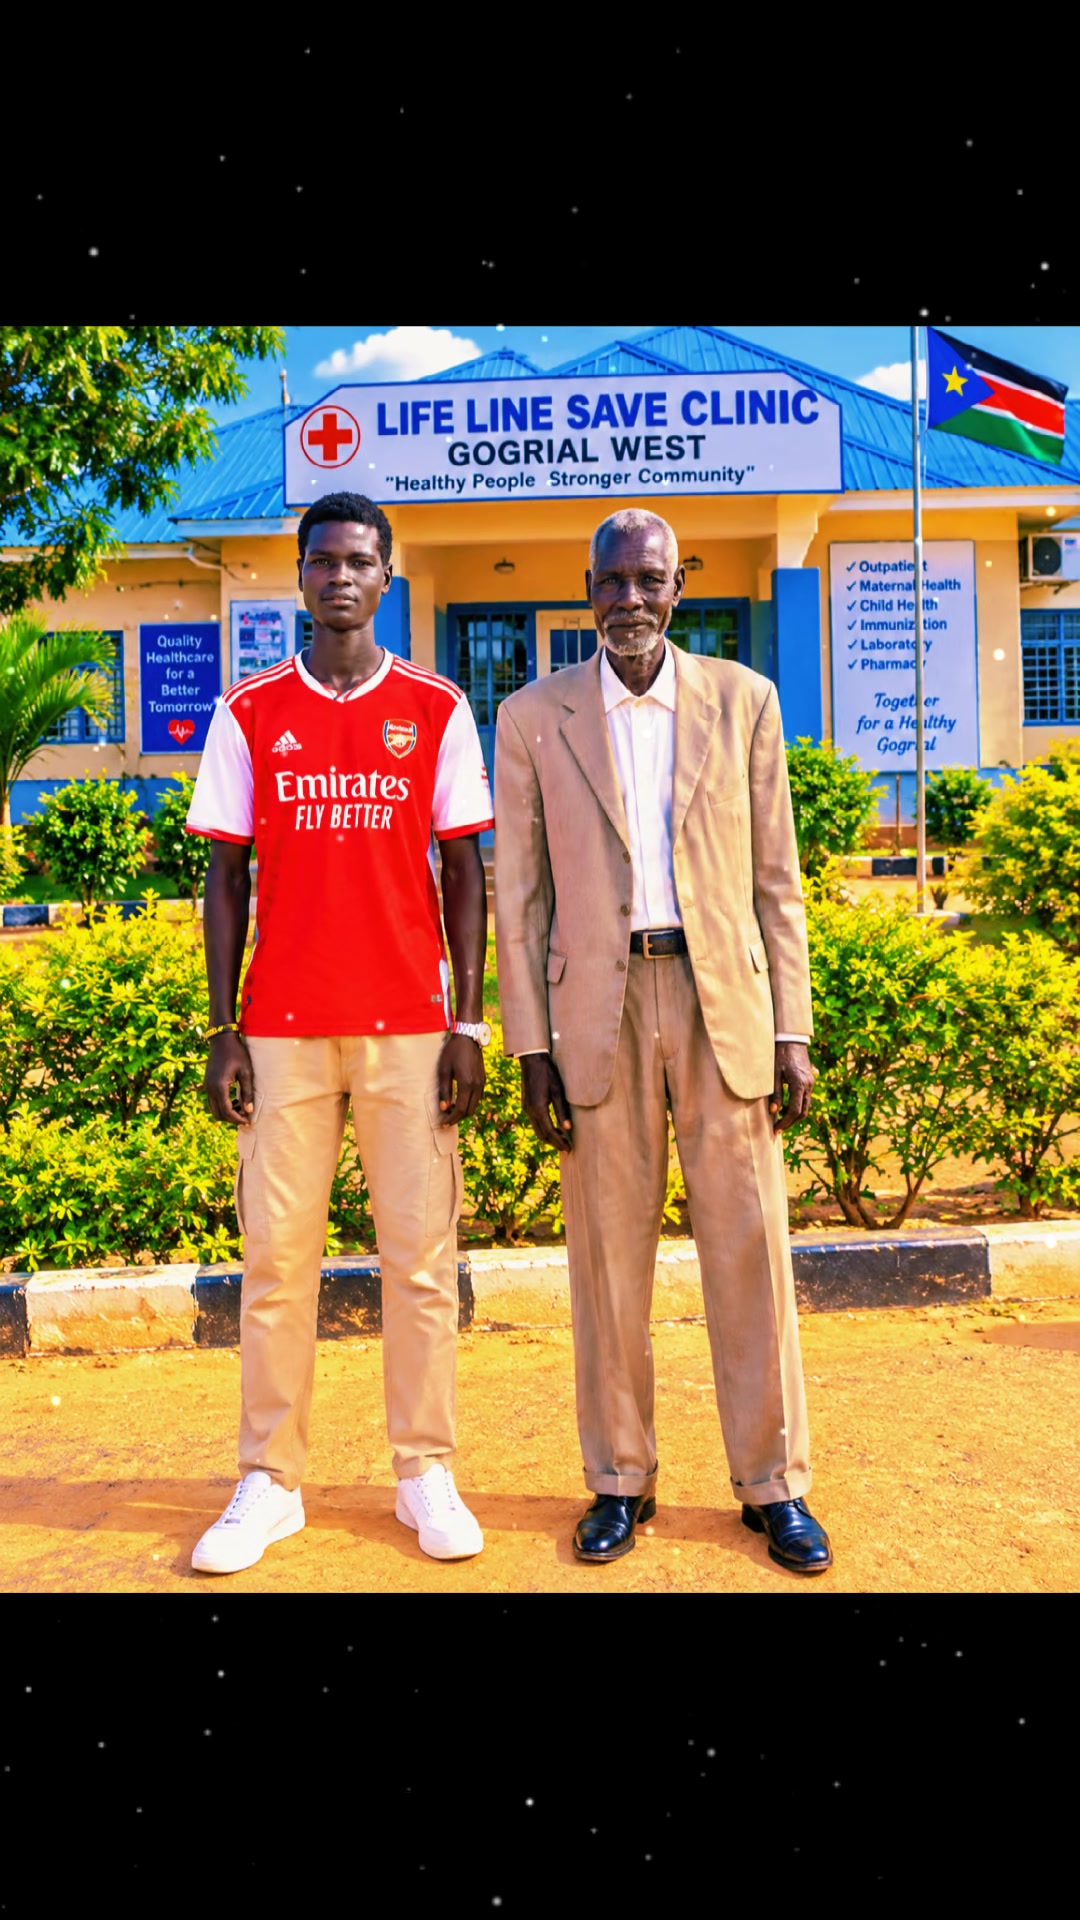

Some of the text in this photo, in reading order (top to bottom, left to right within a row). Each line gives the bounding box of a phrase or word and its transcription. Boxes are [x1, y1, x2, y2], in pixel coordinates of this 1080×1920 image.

[377, 389, 820, 436] LIFE LINE SAVE CLINIC
[447, 435, 706, 466] GOGRIAL WEST
[385, 465, 755, 494] "Healthy People Stronger Community"
[859, 560, 928, 575] Outpatiet
[921, 578, 962, 592] Health
[860, 598, 939, 612] Child Helth
[860, 617, 948, 631] Immuniztion
[157, 633, 203, 650] Quality
[860, 638, 933, 653] Laboratoy
[146, 651, 215, 664] Healthcare
[165, 667, 195, 680] for a
[161, 684, 201, 697] Better
[148, 700, 213, 713] Tomorrow
[874, 692, 940, 712] Togeter
[855, 715, 881, 735] for
[884, 719, 895, 730] a
[274, 765, 411, 803] Emirates
[295, 803, 393, 831] FLY BETTER
